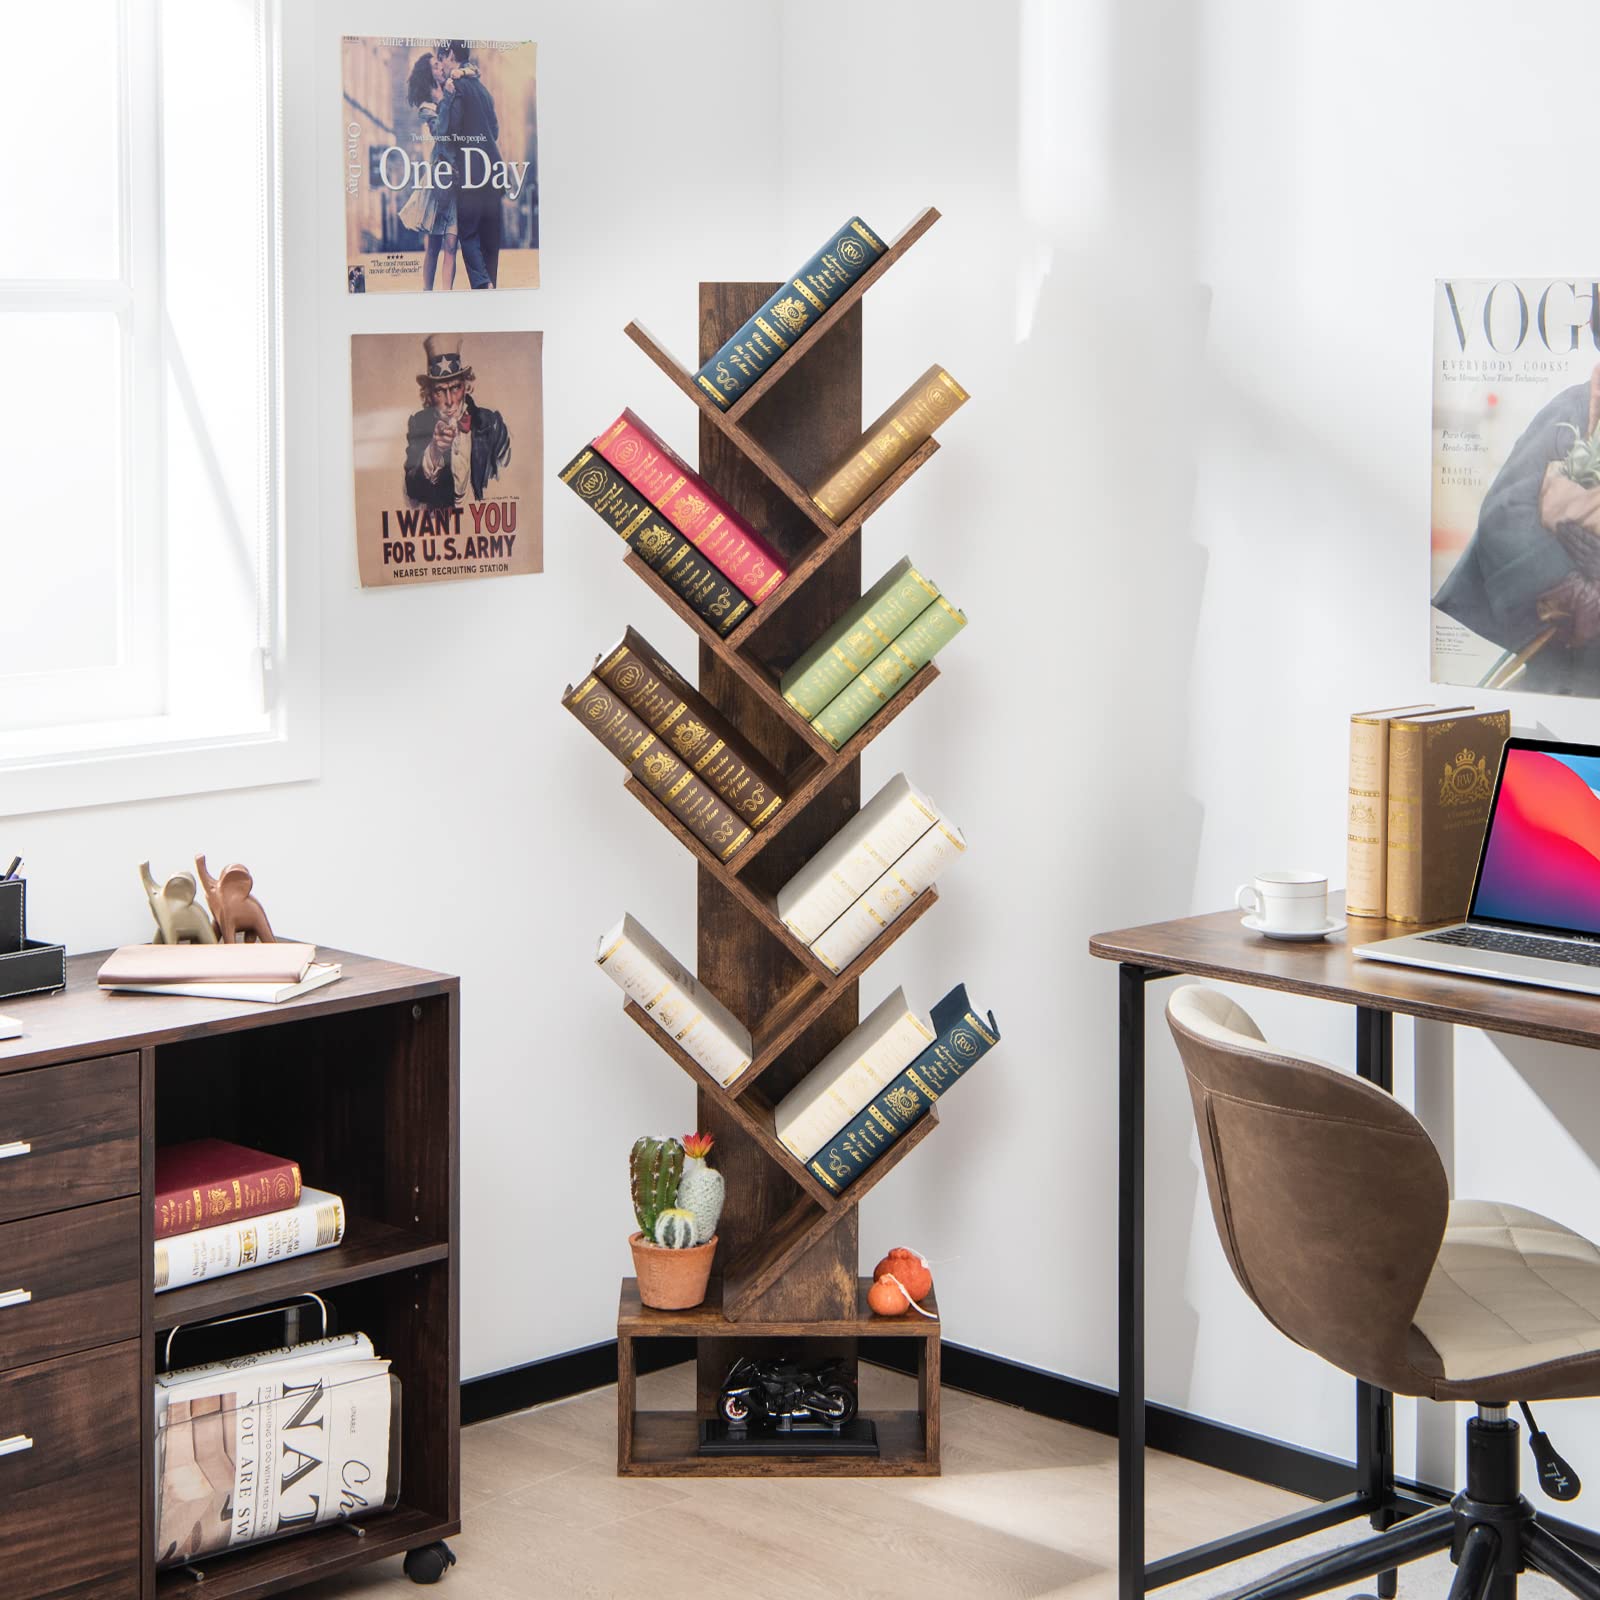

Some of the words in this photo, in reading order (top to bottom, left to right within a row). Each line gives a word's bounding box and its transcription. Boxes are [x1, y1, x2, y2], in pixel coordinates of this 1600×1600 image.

[347, 122, 360, 161] One
[452, 134, 465, 142] Two
[466, 134, 487, 143] people.
[347, 161, 362, 198] Day
[380, 146, 453, 190] One
[461, 147, 529, 200] Day
[382, 511, 389, 539] I
[395, 508, 464, 536] WANT
[469, 502, 517, 534] YOU
[384, 539, 415, 564] FOR
[393, 568, 428, 578] NEAREST
[432, 565, 477, 576] RECRUITING
[479, 564, 509, 573] STATION
[957, 1036, 974, 1053] RW
[240, 1400, 254, 1445] YOU
[264, 1401, 272, 1437] NOTHING
[265, 1438, 271, 1449] TO
[264, 1451, 271, 1462] DO
[239, 1457, 254, 1498] ARE
[262, 1486, 268, 1496] ME
[262, 1498, 268, 1508] TO
